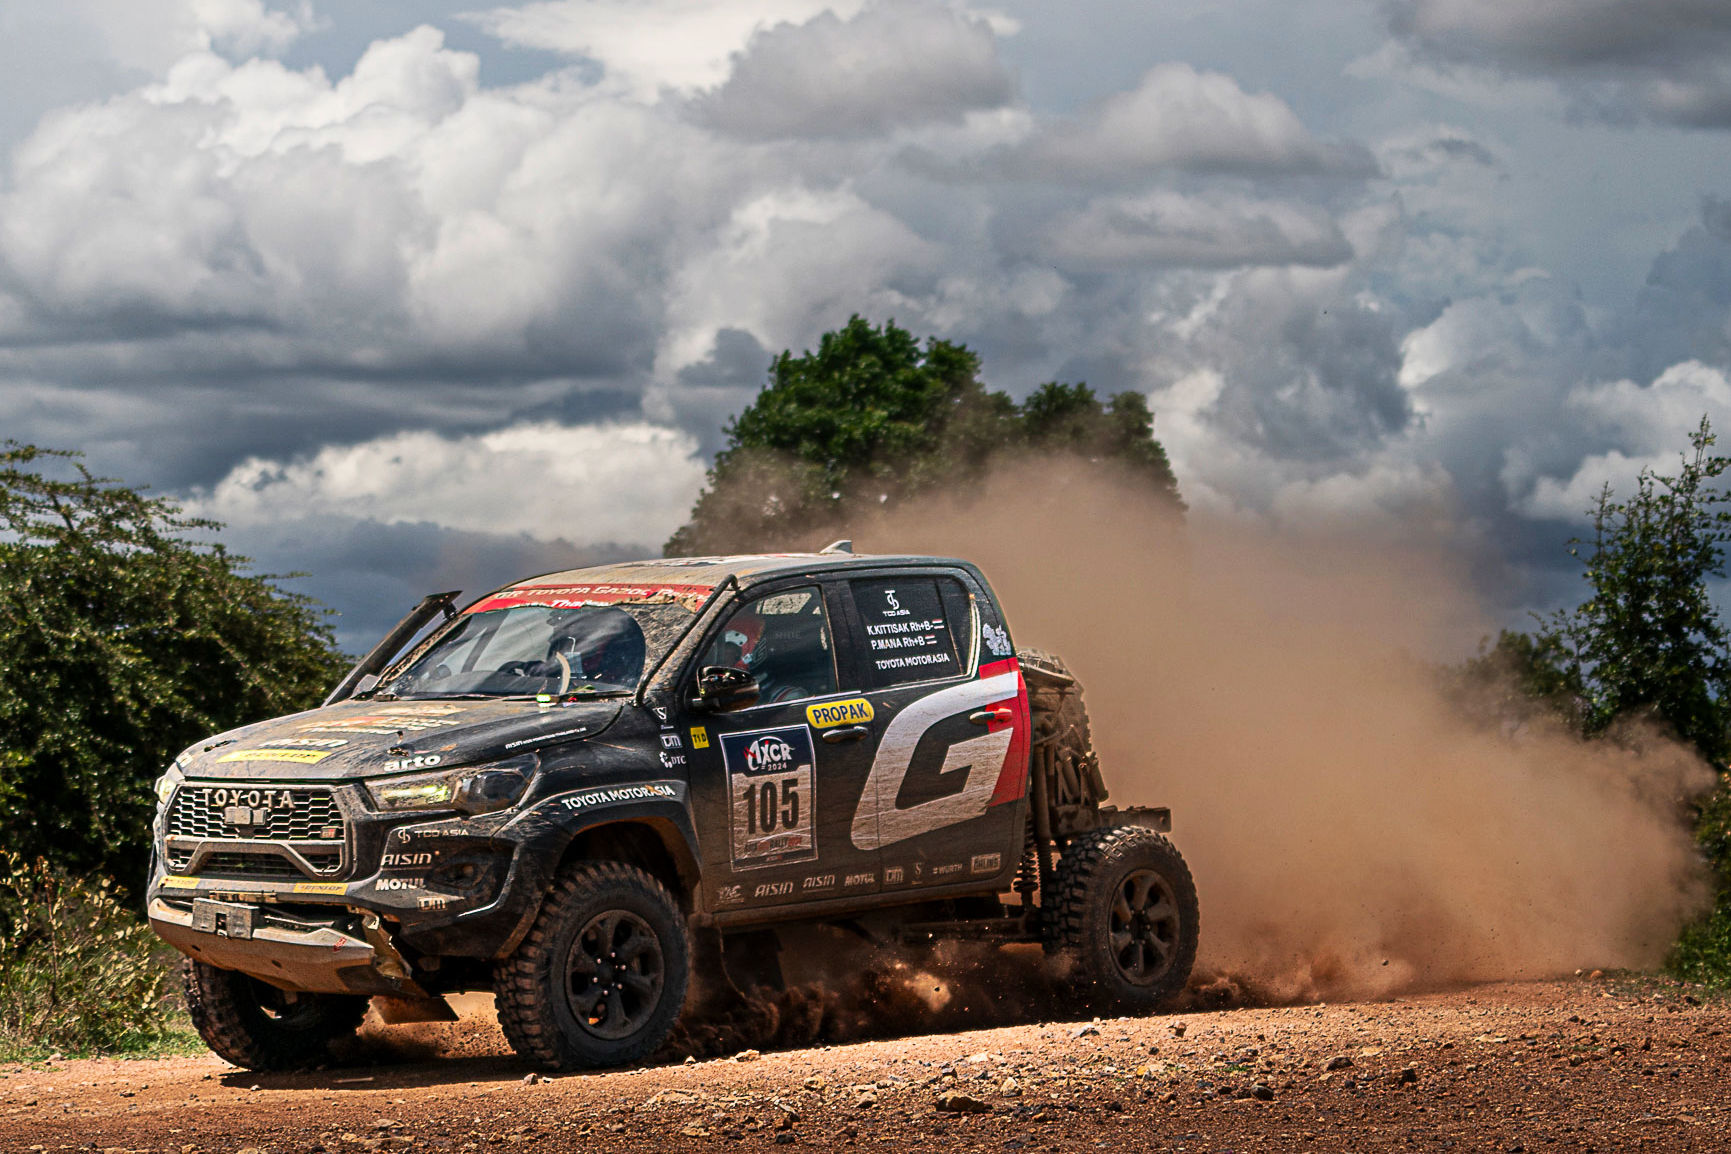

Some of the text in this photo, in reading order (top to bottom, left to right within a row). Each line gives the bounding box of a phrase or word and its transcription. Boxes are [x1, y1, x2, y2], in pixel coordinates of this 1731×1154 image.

[528, 587, 591, 596] TOYOTA
[871, 635, 926, 650] P.MANA Rh+B
[875, 658, 906, 670] TOYOTA
[812, 702, 869, 724] PROPAK
[383, 755, 441, 772] arto
[670, 755, 687, 765] DTC
[767, 762, 788, 772] 2024
[202, 788, 297, 809] TOYOTA
[562, 792, 609, 810] TOYOTA
[742, 778, 799, 834] 105
[441, 828, 470, 836] ASIA
[380, 853, 432, 866] AISIN
[375, 878, 426, 891] MOTUL
[802, 874, 836, 888] AISIN
[754, 881, 794, 897] AISIN
